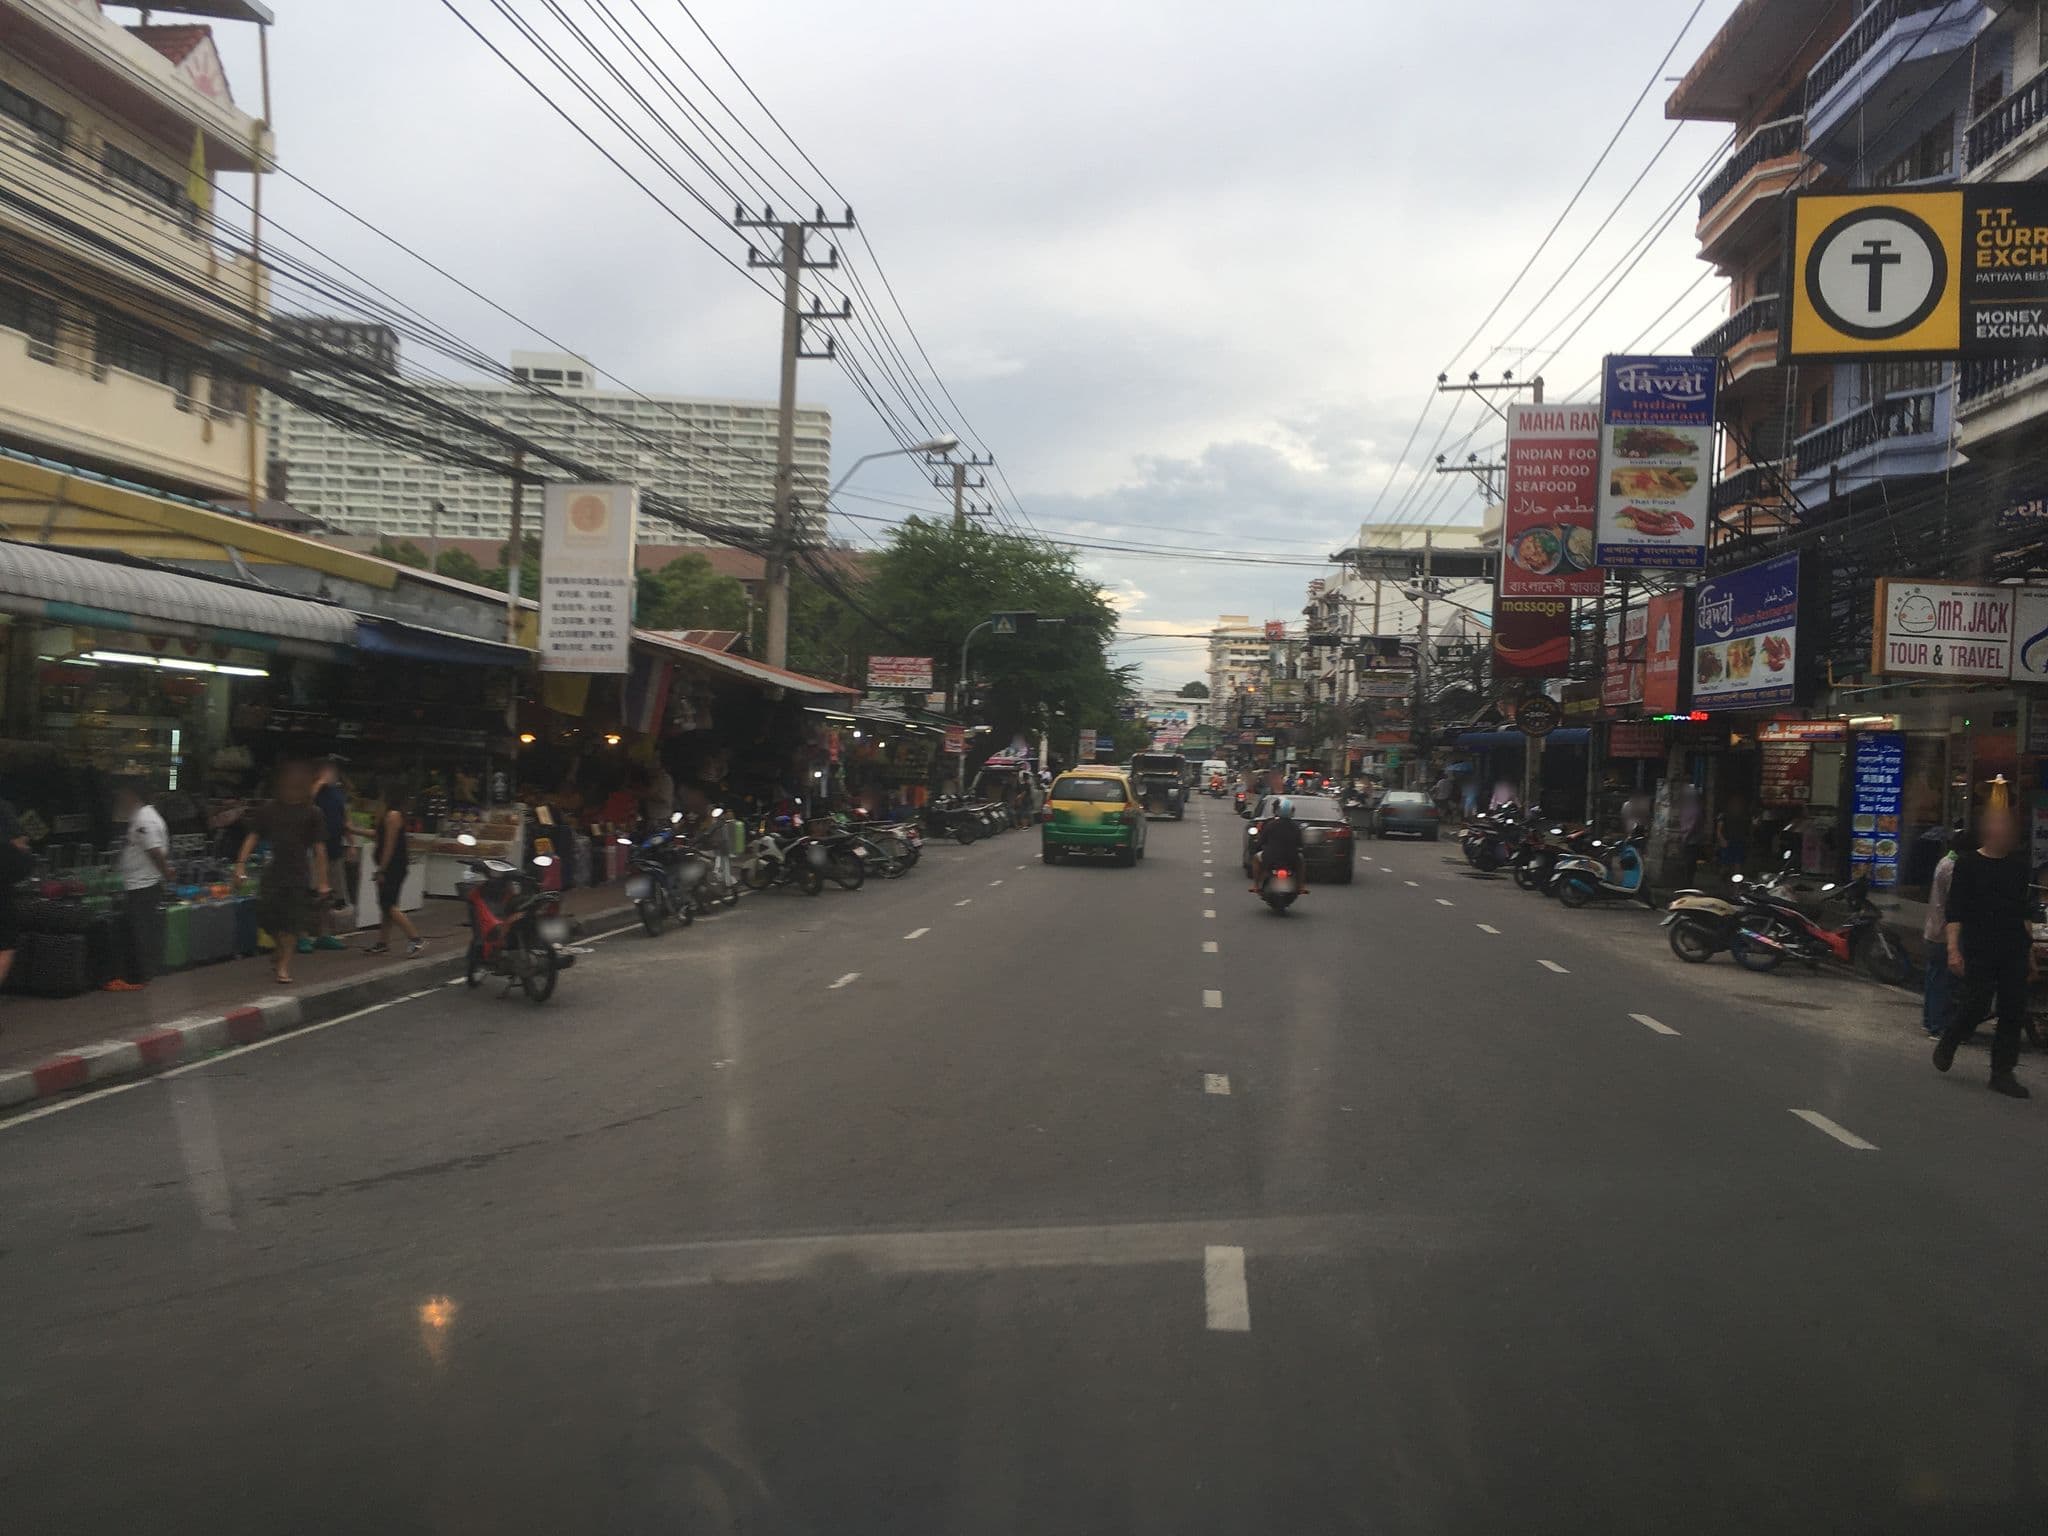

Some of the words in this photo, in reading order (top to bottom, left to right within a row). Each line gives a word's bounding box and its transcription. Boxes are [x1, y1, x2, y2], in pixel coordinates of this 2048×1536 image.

[1976, 207, 2018, 228] T.T.
[1976, 227, 2048, 249] CURR
[1976, 246, 2048, 268] EXCH
[1976, 272, 2023, 284] PATTAYA
[1976, 308, 2043, 325] MONEY
[1976, 323, 2048, 339] EXCHAN
[1518, 411, 1565, 433] MAHA
[1516, 447, 1564, 461] INDIAN
[1515, 464, 1546, 477] THAI
[1552, 464, 1590, 477] FOOD
[1514, 480, 1578, 494] SEAFOOD
[1501, 600, 1566, 618] massage
[1889, 641, 1928, 665] TOUR
[1932, 644, 1943, 666] &
[1949, 644, 2004, 670] TRAVEL
